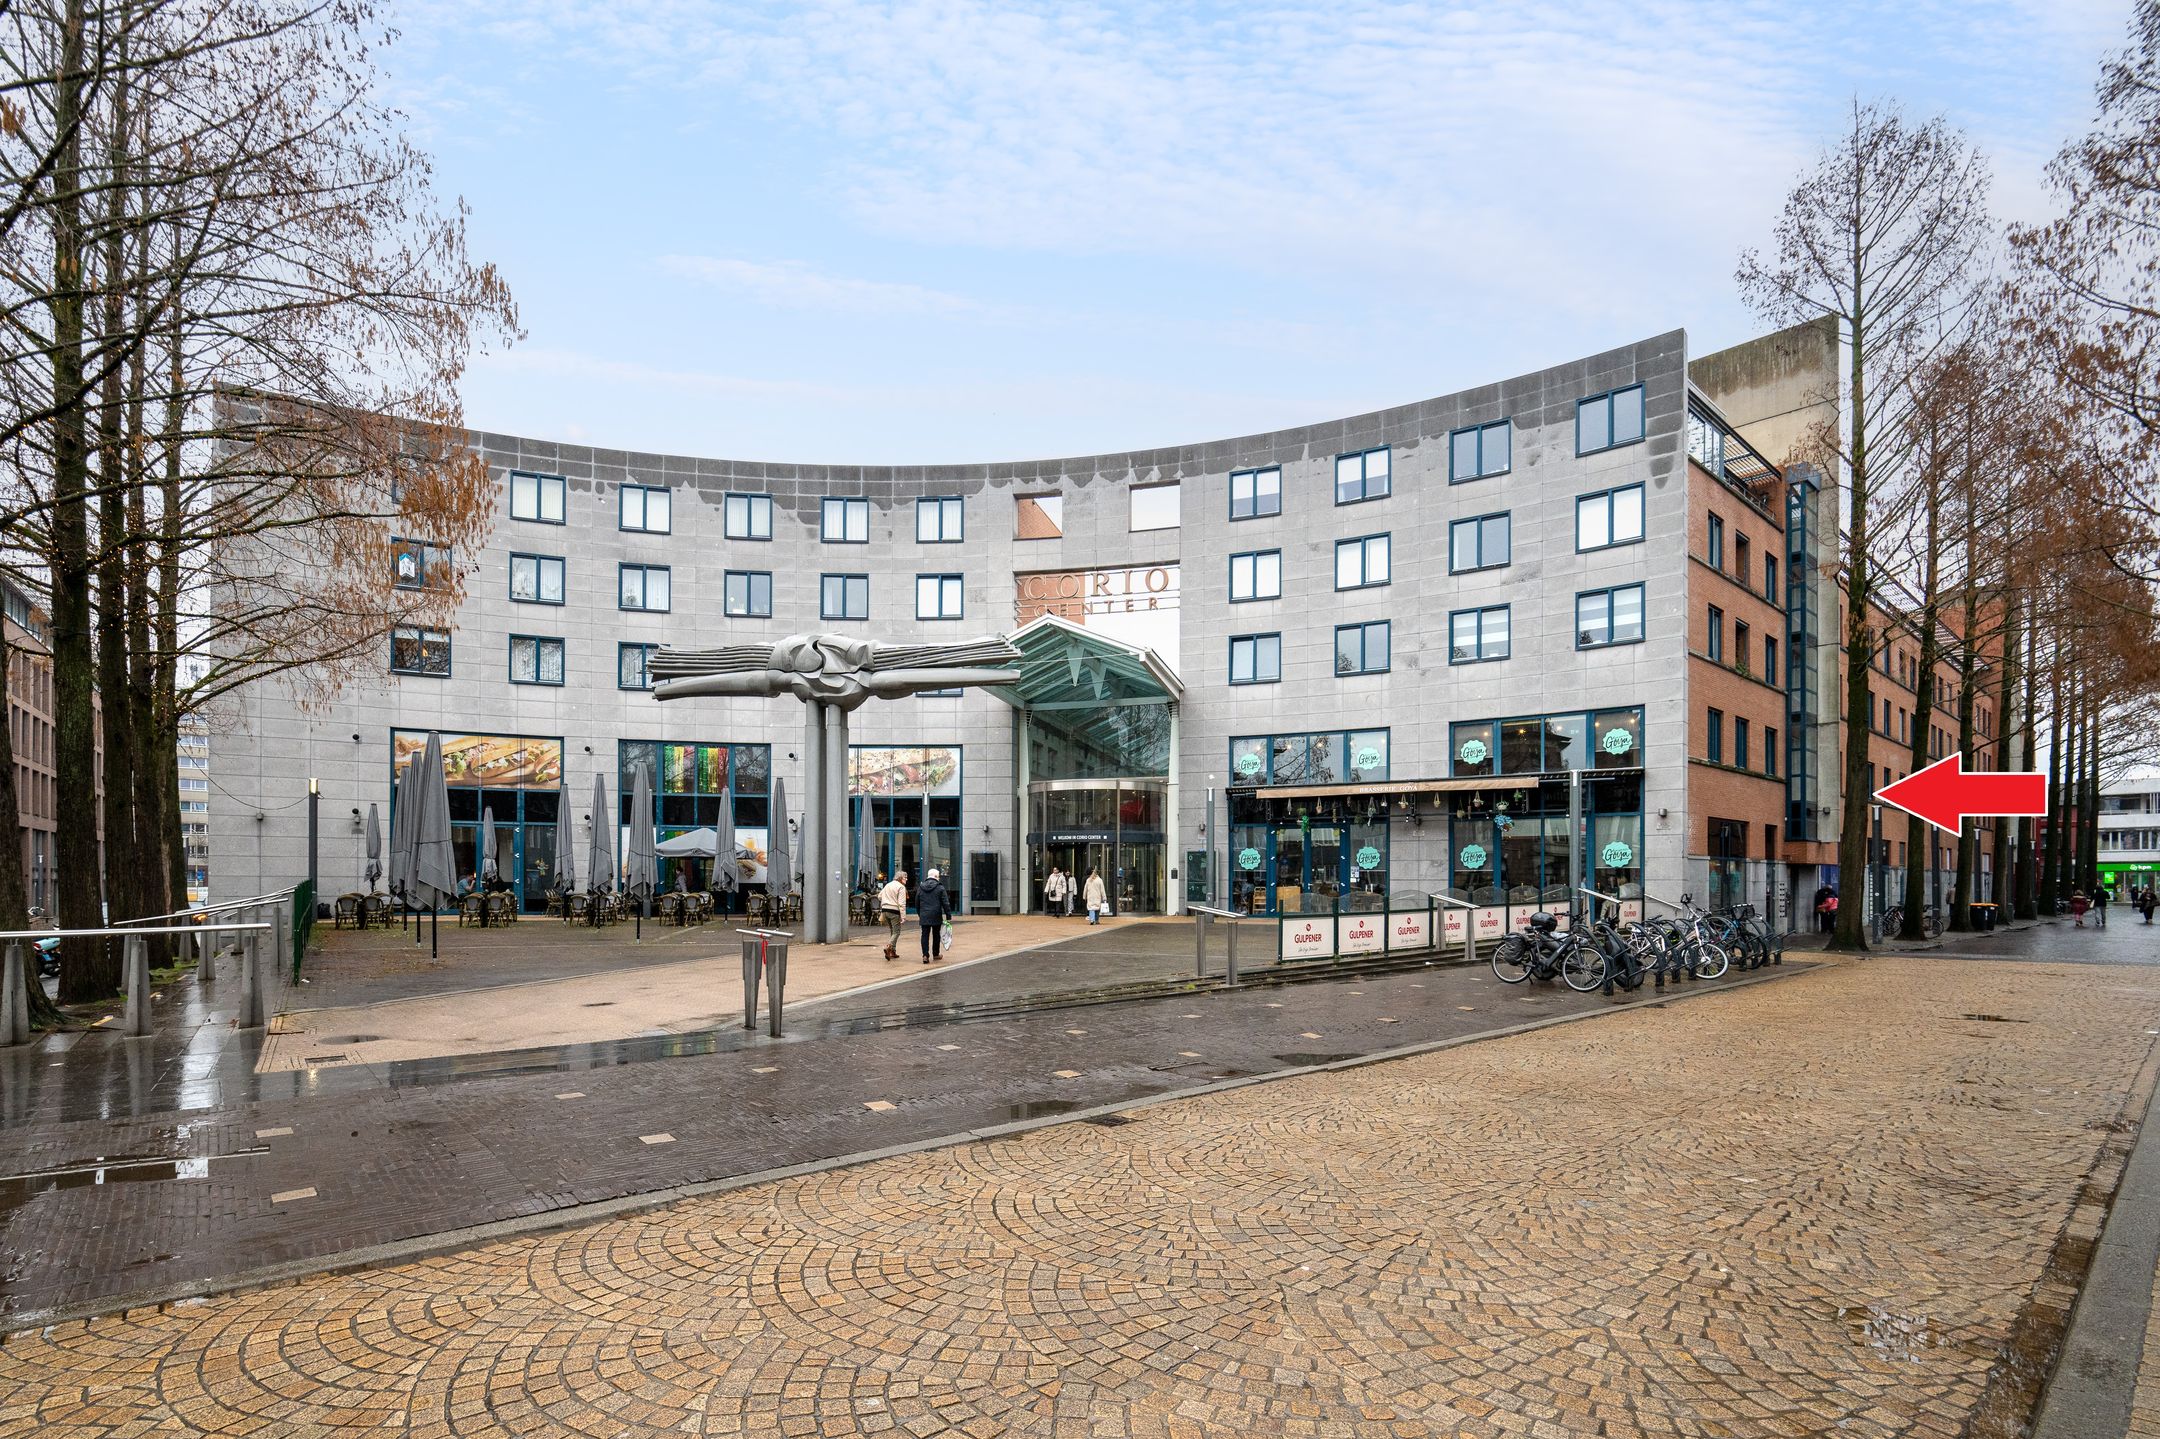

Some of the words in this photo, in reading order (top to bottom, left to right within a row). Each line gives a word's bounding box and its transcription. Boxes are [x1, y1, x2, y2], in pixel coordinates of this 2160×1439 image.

[1024, 568, 1169, 600] CORIO
[1034, 597, 1159, 617] CENTER
[1605, 736, 1631, 750] Goya
[1358, 753, 1379, 765] Goya
[1462, 747, 1485, 759] Goya
[1240, 760, 1260, 771] Goya
[1240, 853, 1260, 865] Goya
[1358, 852, 1379, 864] Goya
[1462, 851, 1485, 863] Goya
[1604, 848, 1630, 862] Goya
[1444, 922, 1461, 931] ULPENER
[1480, 920, 1498, 928] GULPENER
[1349, 930, 1373, 939] GULPENER
[1397, 926, 1420, 936] GULPENER
[1294, 933, 1322, 943] GULPENER
